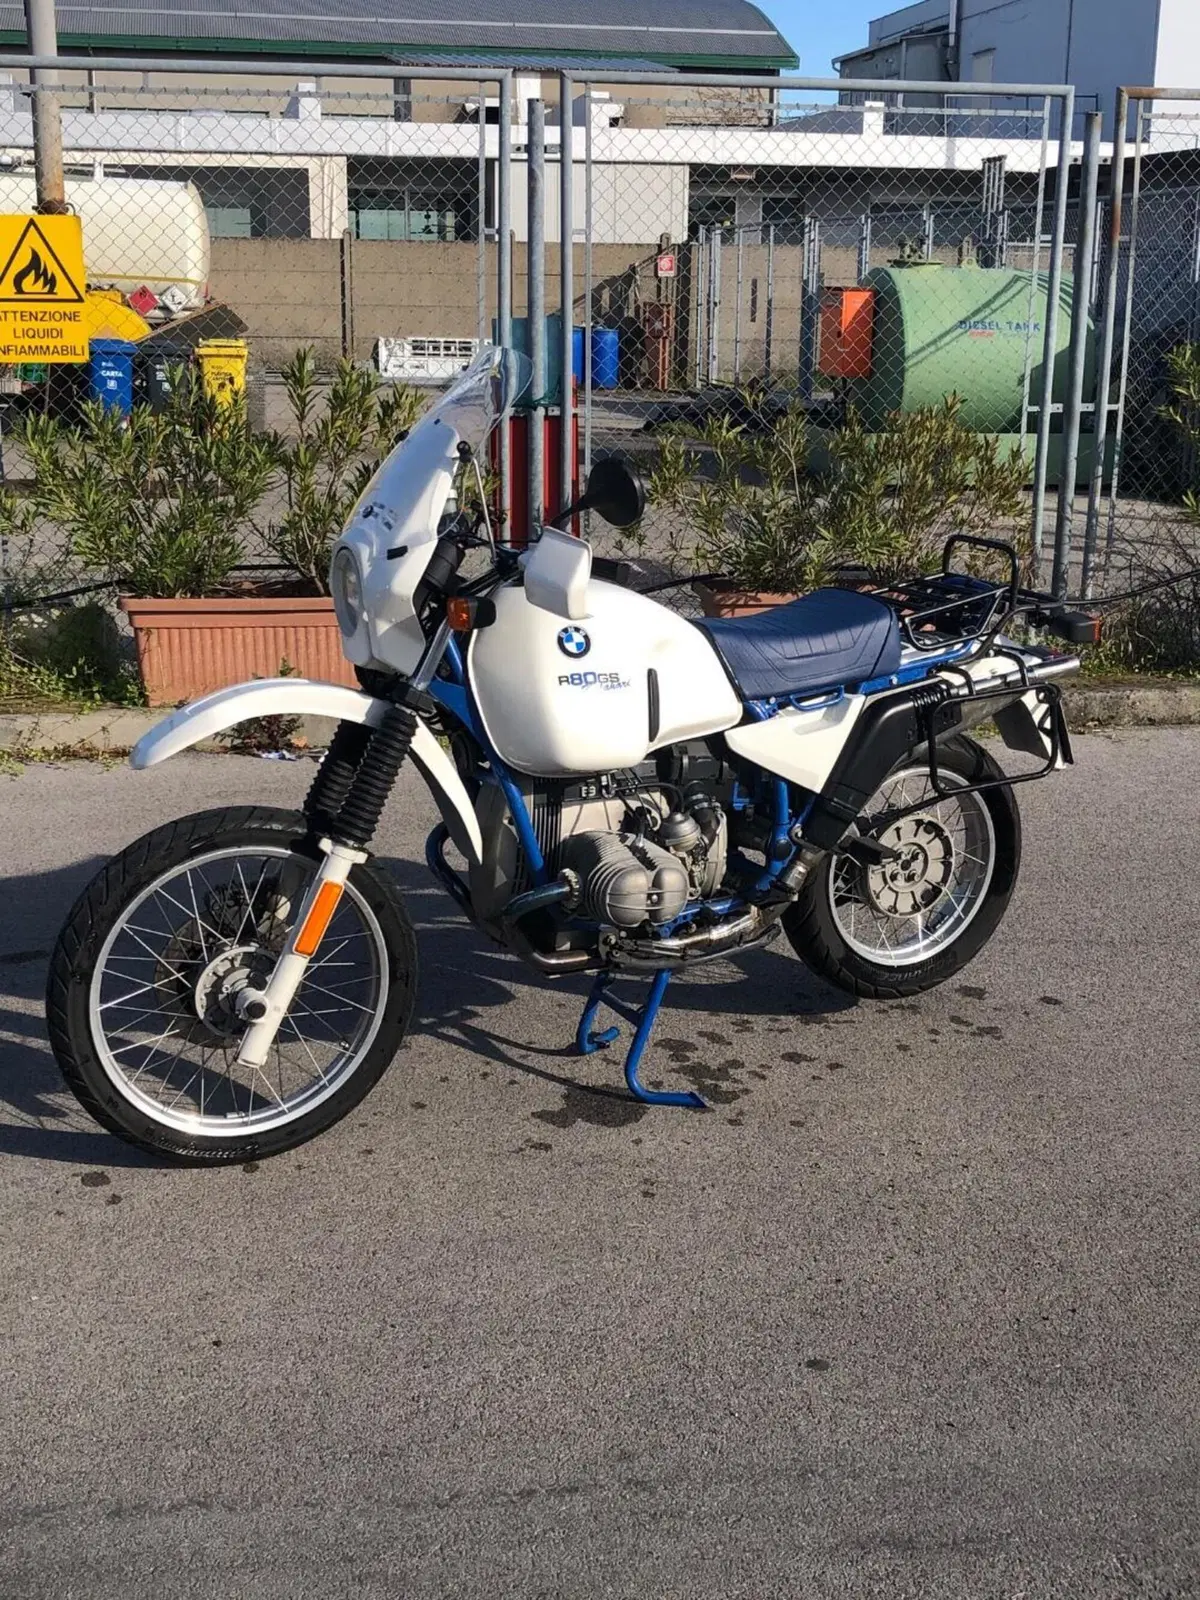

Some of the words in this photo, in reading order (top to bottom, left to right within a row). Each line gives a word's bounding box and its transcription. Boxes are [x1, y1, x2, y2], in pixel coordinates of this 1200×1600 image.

[0, 311, 82, 322] TTENZIONE
[959, 320, 1001, 330] DIESEL
[1006, 322, 1040, 332] TANK
[13, 328, 64, 339] LIQUIDI
[0, 345, 85, 356] NFIAMMABILI
[101, 370, 123, 378] CARTA
